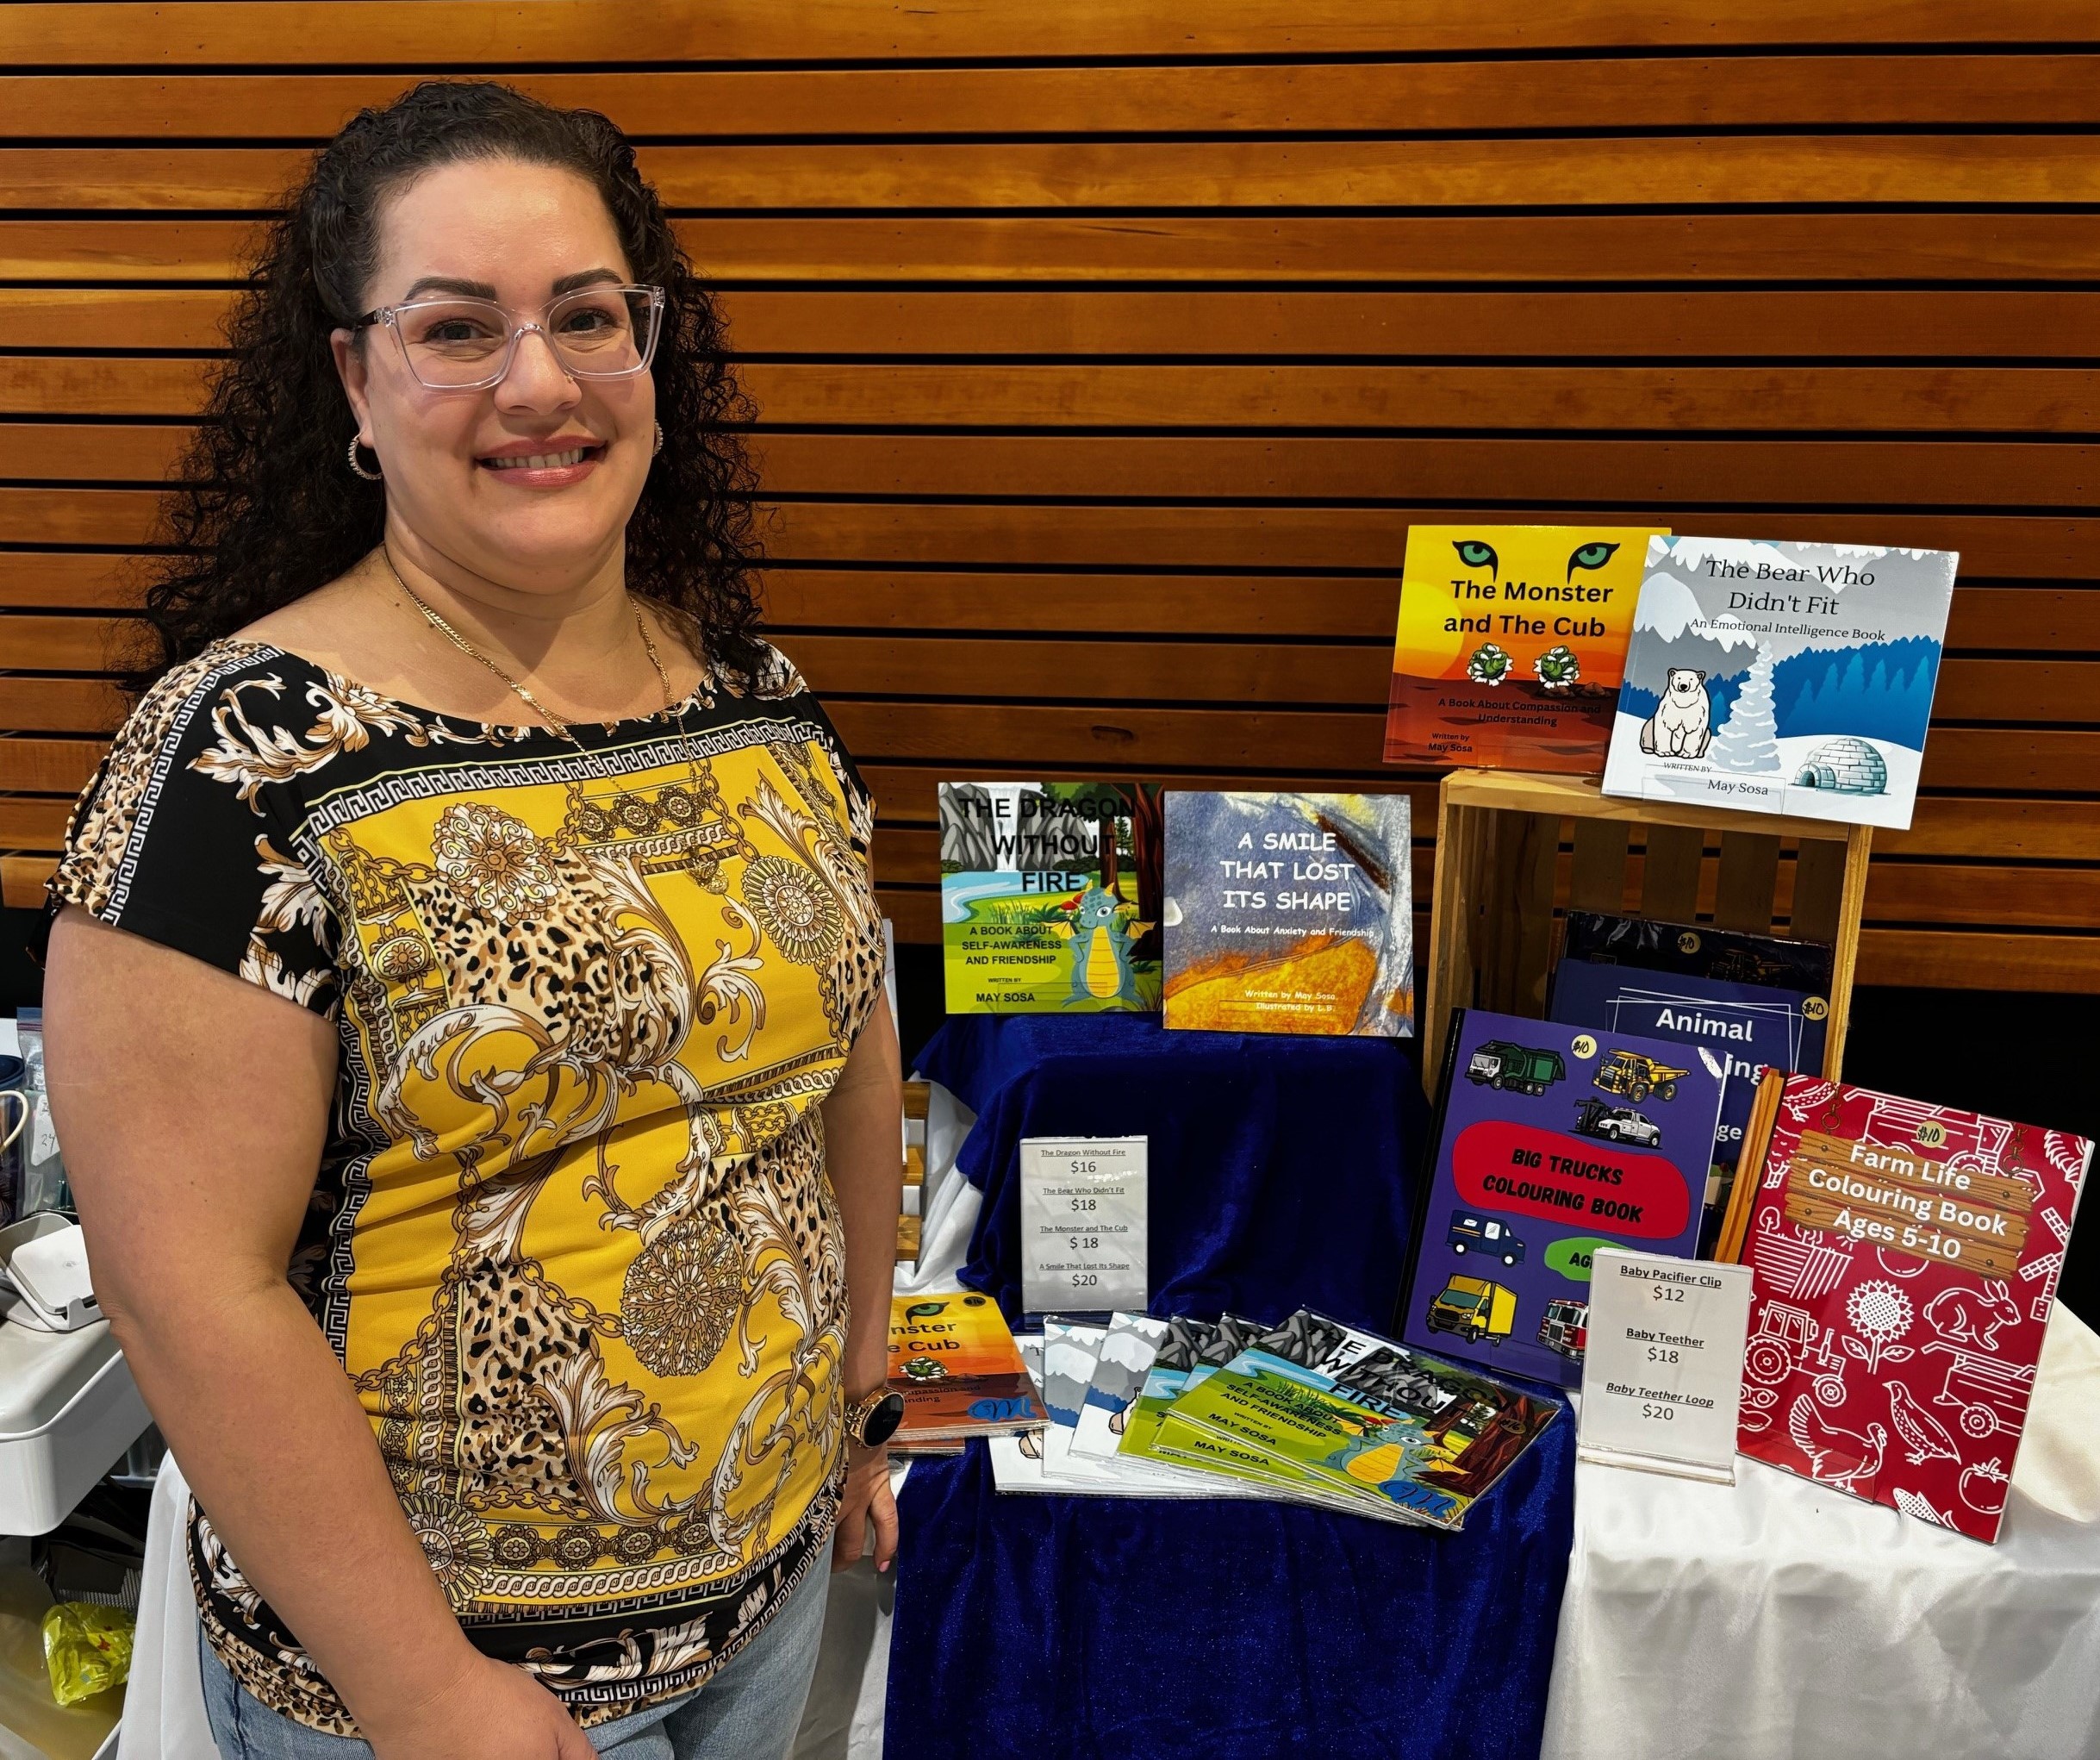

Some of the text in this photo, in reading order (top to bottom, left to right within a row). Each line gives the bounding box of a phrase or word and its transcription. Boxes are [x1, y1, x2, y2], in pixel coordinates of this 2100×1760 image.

[1706, 559, 1875, 586] The Bear Who
[1450, 580, 1614, 603] The Monster
[1728, 591, 1839, 615] Didn't Fit
[1443, 615, 1605, 637] and The Cub
[1691, 619, 1885, 641] An Emotional Intelligence Book
[1449, 699, 1475, 708] Book
[1478, 700, 1510, 709] About
[1512, 702, 1578, 713] Compassion
[1582, 704, 1601, 714] and
[1478, 714, 1557, 727] Understanding
[1429, 743, 1473, 753] May Sosa
[1663, 762, 1700, 771] WRITTEN
[1707, 779, 1768, 795] May Sosa
[963, 798, 1135, 818] THE DRAGON
[991, 835, 1115, 855] WITHOUT
[1237, 833, 1336, 852] A SMILE
[1219, 860, 1355, 881] THAT LOST
[1022, 872, 1081, 892] FIRE
[1223, 890, 1350, 911] ITS SHAPE
[969, 926, 1053, 935] A BOOK ABOUT
[1221, 925, 1241, 933] Book
[1244, 926, 1269, 934] About
[1274, 927, 1307, 937] Anxiety
[1311, 927, 1325, 936] and
[1329, 928, 1374, 939] Friendship
[962, 941, 1062, 951] SELF-AWARENESS
[966, 955, 1056, 964] AND FRIENDSHIP
[976, 993, 1035, 1002] MAY SOSA
[1281, 990, 1292, 1001] by
[1295, 992, 1312, 1002] May
[1256, 1002, 1301, 1012] Illustrated
[1304, 1004, 1314, 1014] by
[1803, 1002, 1825, 1015] $10
[1655, 1008, 1754, 1042] Animal
[1572, 1041, 1589, 1054] $10
[1916, 1127, 1941, 1143] $10
[1071, 1160, 1096, 1174] $16
[1511, 1148, 1623, 1186] BIG TRUCKS
[1850, 1145, 1972, 1191] Farm Life
[1071, 1198, 1096, 1212] $18
[1483, 1174, 1645, 1224] COLOURING BOOK
[1808, 1168, 2009, 1236] Colouring Book
[1833, 1210, 1961, 1259] Ages 5-10
[1072, 1274, 1097, 1288] $20
[1620, 1265, 1723, 1289] Baby Pacifier Clip
[1653, 1285, 1685, 1302] $12
[891, 1323, 957, 1334] nster
[1626, 1327, 1704, 1347] Baby Teether
[908, 1339, 960, 1351] Cub
[1647, 1346, 1679, 1364] $18
[1308, 1325, 1508, 1413] THE DRAGON
[1321, 1351, 1468, 1420] WITHOUT
[1606, 1382, 1714, 1408] Baby Teether Loop
[1226, 1384, 1343, 1435] SELF-AWARENESS
[1256, 1386, 1293, 1405] BOOK
[1294, 1403, 1338, 1424] ABOUT
[1328, 1381, 1408, 1420] FIRE
[1220, 1393, 1326, 1439] AND FRIENDSHIP
[1234, 1412, 1262, 1426] WRITTEN
[1642, 1403, 1674, 1420] $20
[1208, 1414, 1238, 1427] MAY
[1240, 1426, 1276, 1445] SOSA
[1194, 1441, 1269, 1465] MAY SOSA
